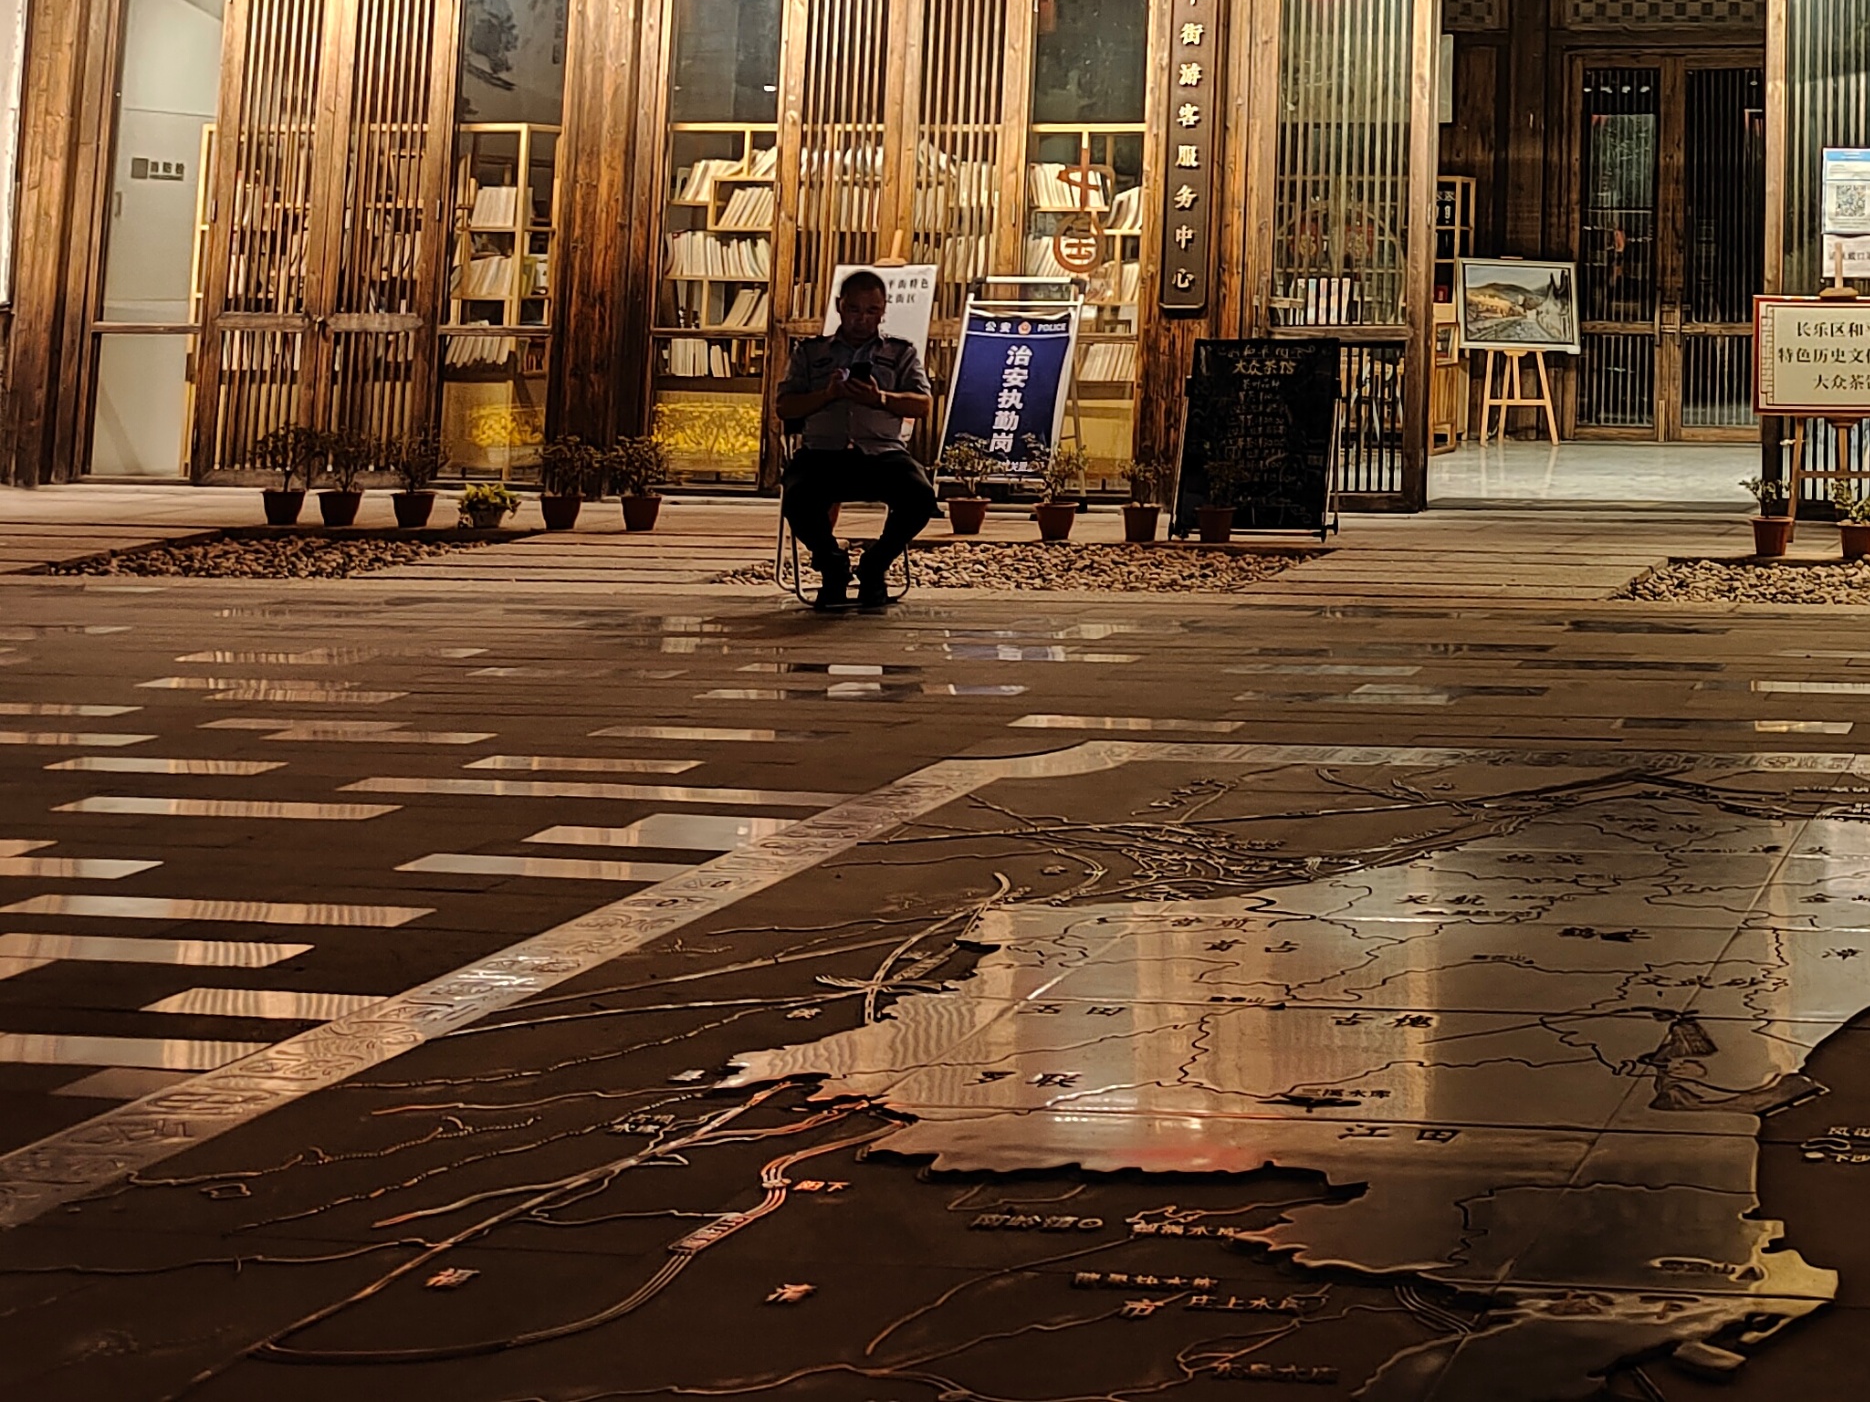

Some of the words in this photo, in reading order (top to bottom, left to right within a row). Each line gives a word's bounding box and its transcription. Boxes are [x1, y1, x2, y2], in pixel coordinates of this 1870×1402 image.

[984, 320, 1013, 334] 公安
[1036, 322, 1067, 333] POLICE
[988, 344, 1034, 454] 治安执勤岗
[1331, 1013, 1433, 1028] 古槐
[1337, 1124, 1461, 1142] 江田
[1122, 1298, 1164, 1318] 市
